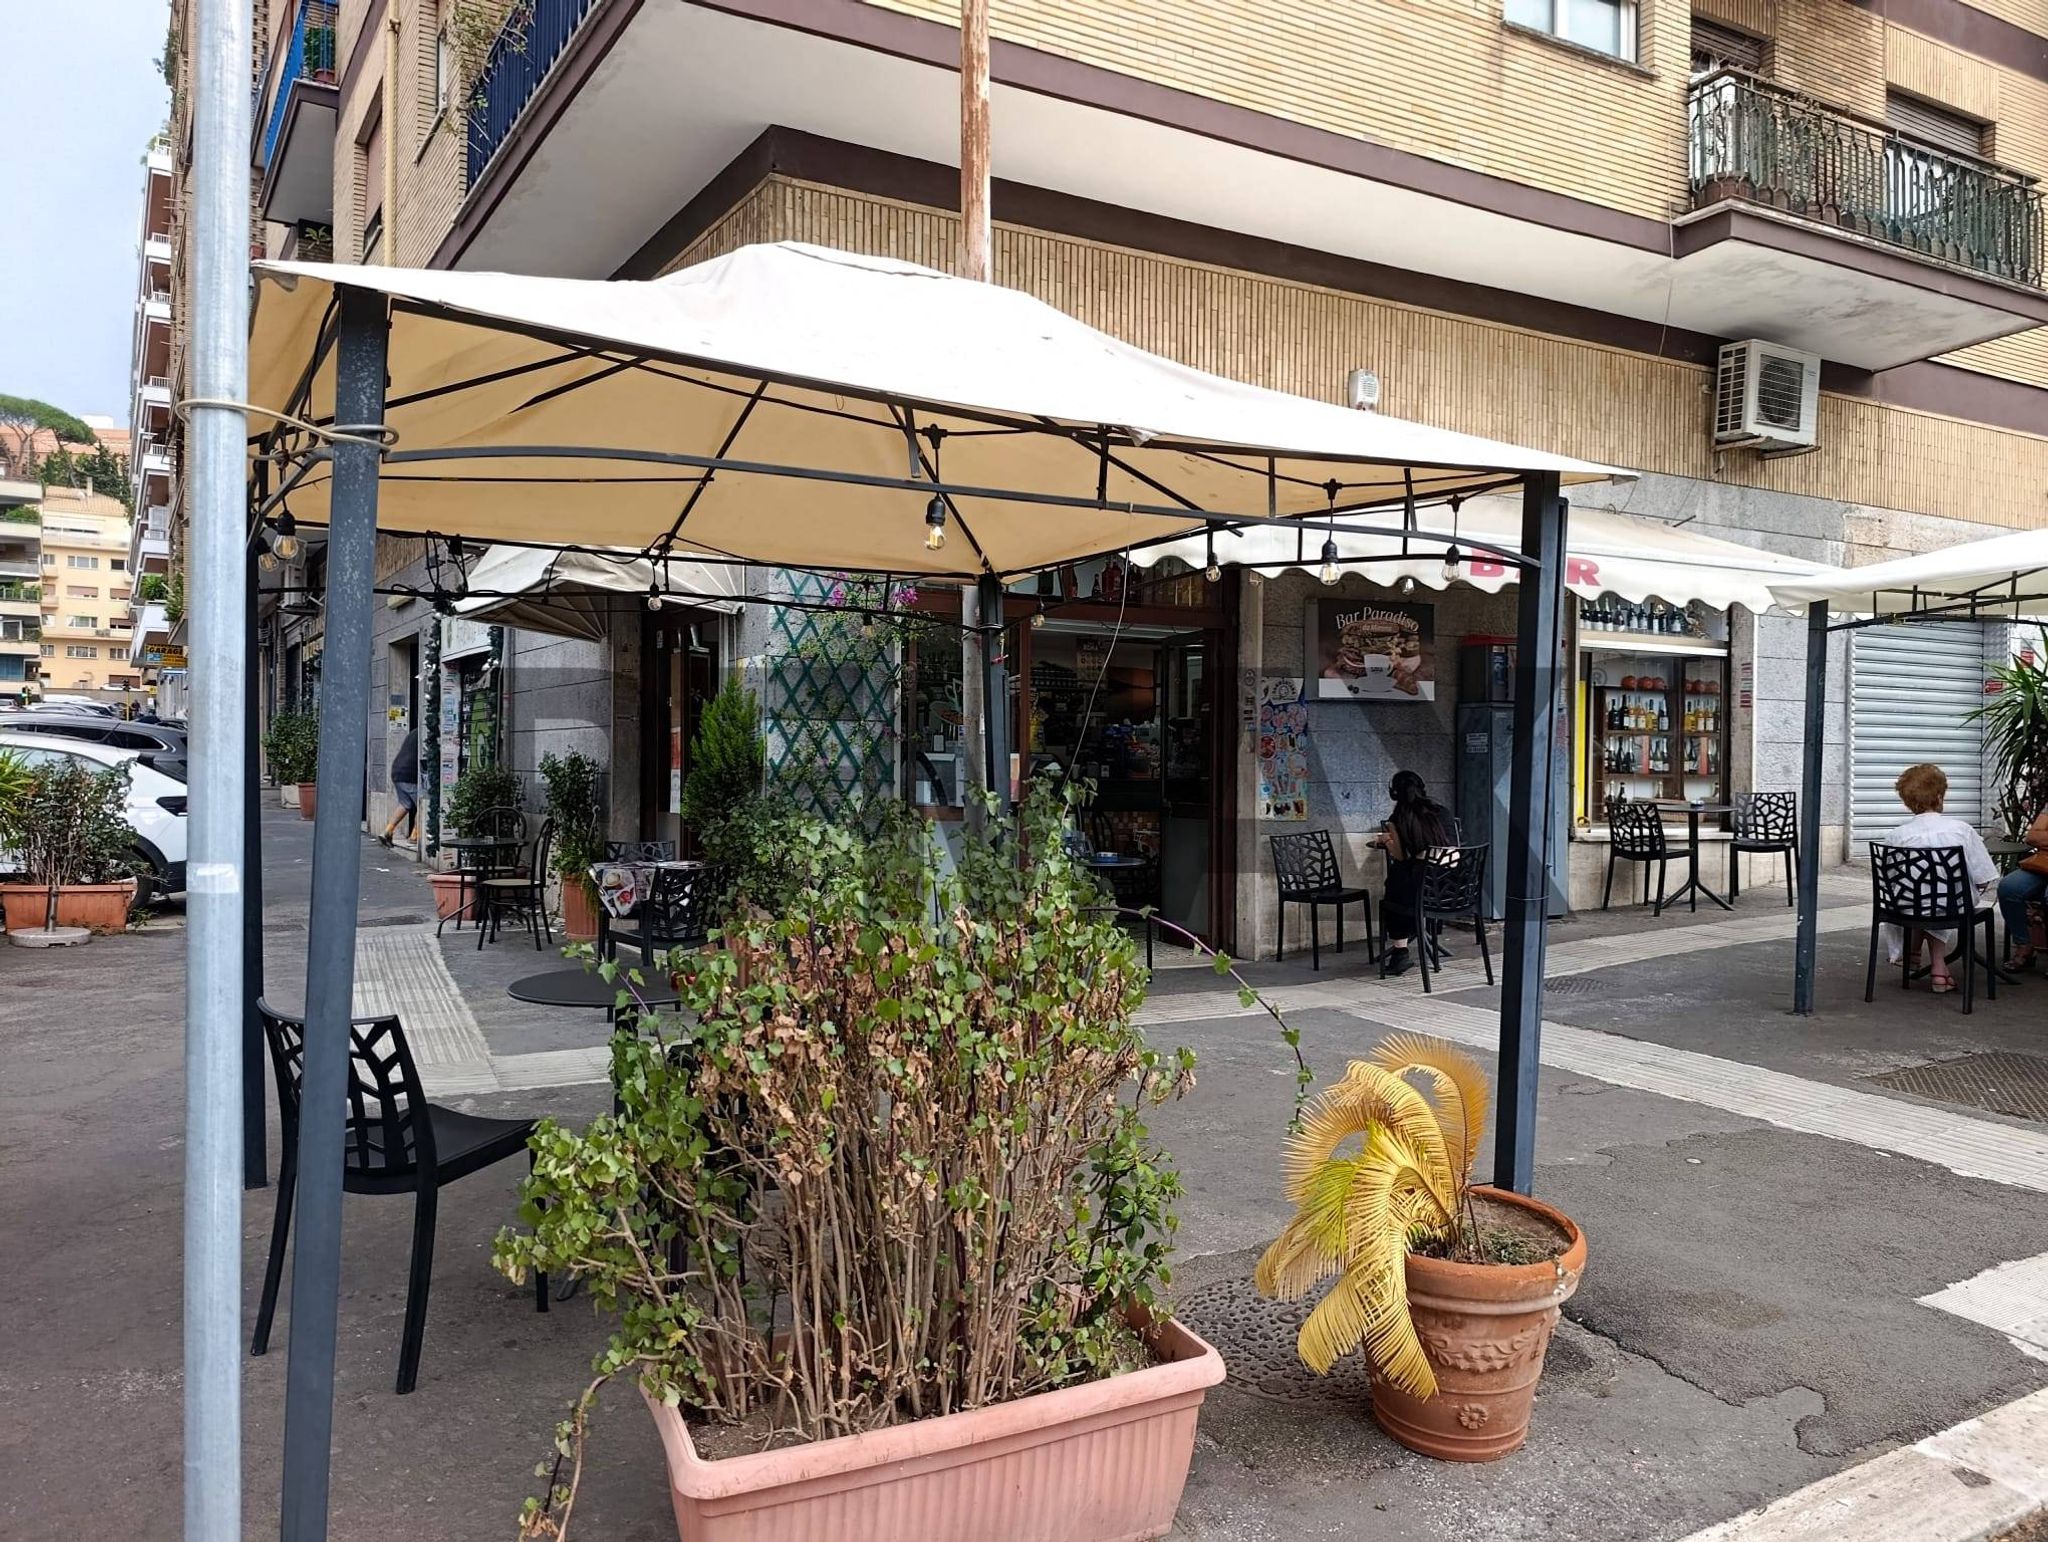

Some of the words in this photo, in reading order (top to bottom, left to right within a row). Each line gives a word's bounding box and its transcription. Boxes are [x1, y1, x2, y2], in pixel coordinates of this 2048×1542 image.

[1470, 547, 1601, 587] BR
[1336, 611, 1360, 630] Bar
[1363, 606, 1419, 632] Paradiso
